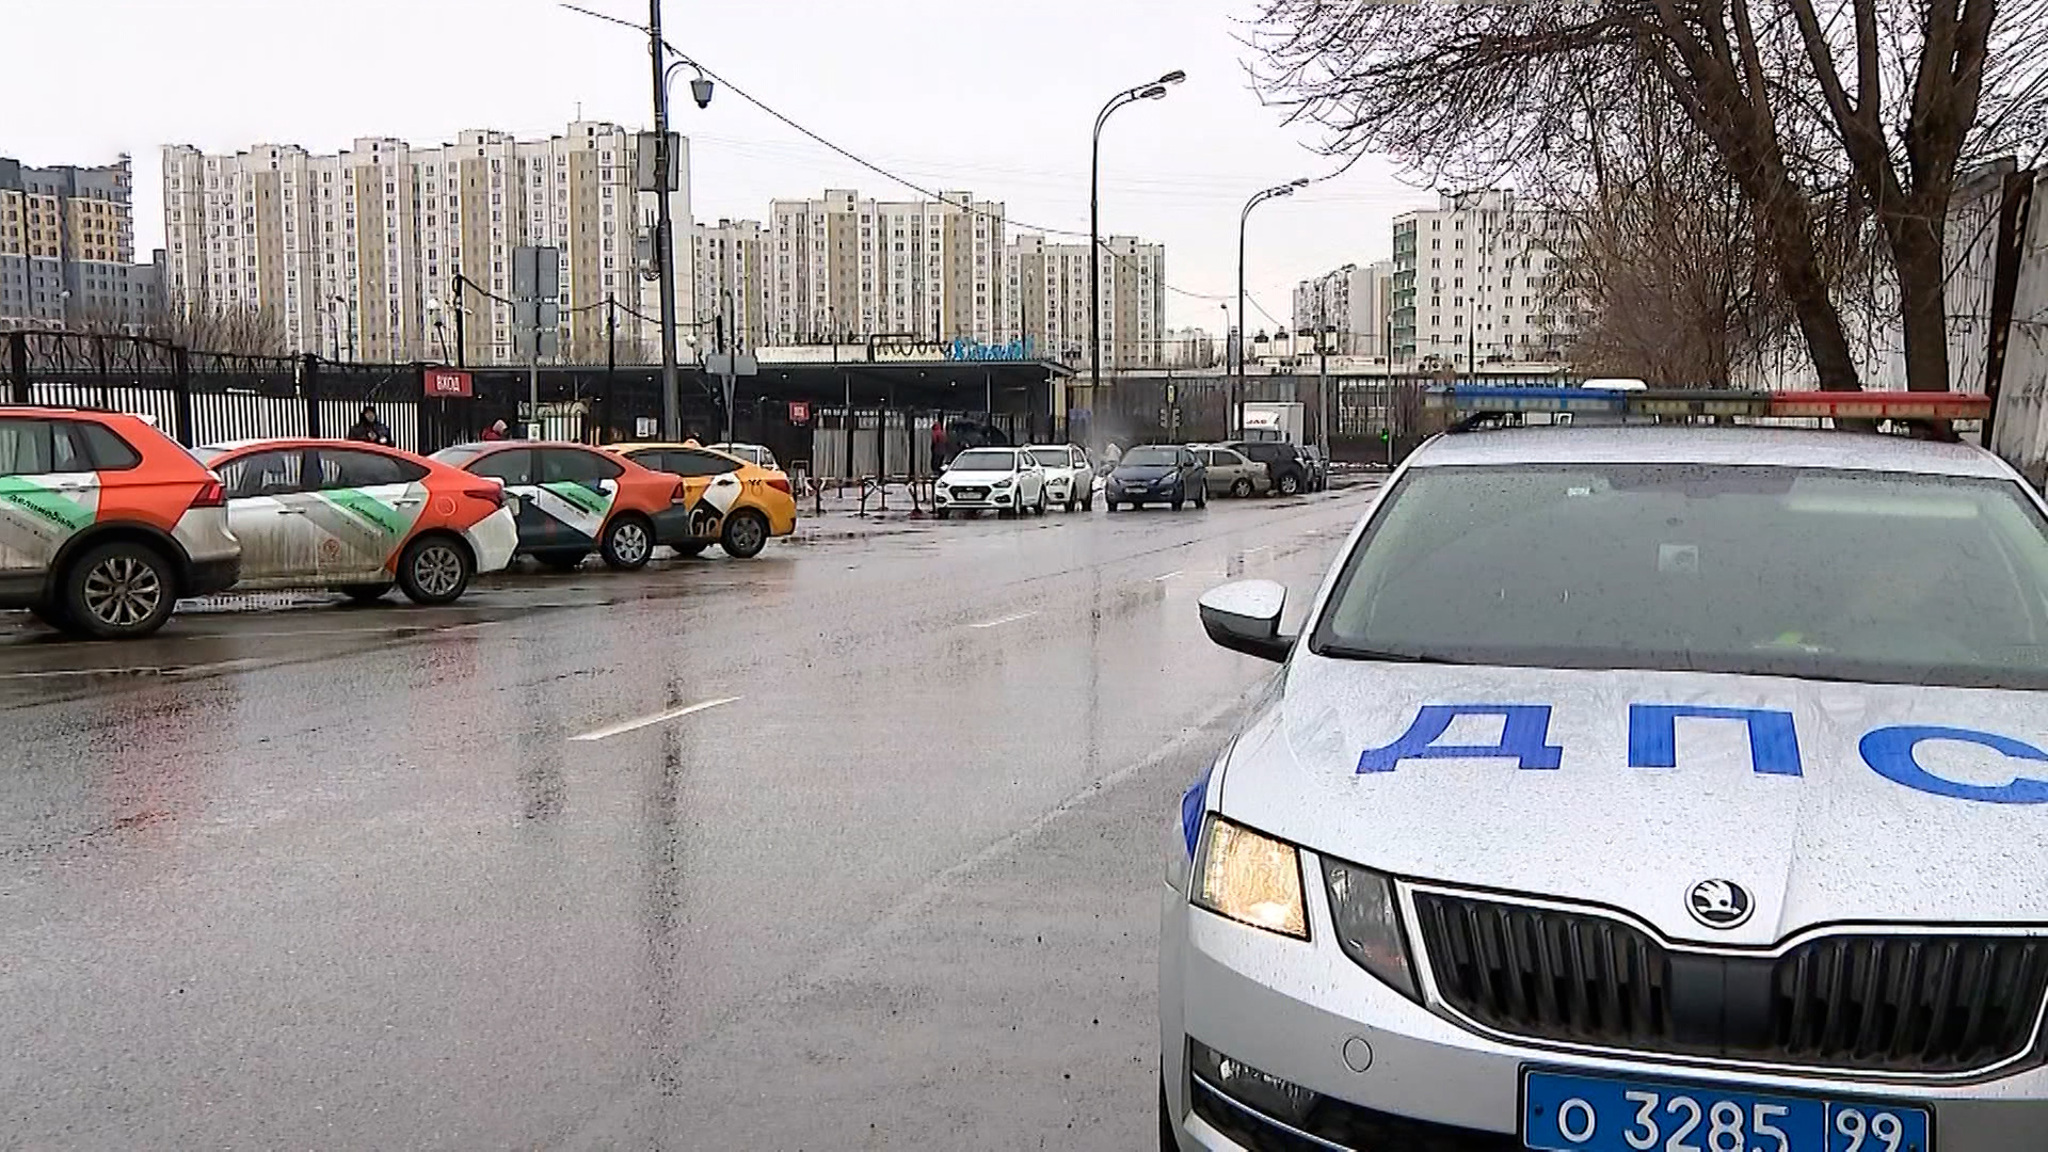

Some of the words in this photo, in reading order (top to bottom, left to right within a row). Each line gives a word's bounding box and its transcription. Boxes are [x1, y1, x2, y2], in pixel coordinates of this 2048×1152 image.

[436, 374, 461, 392] ВХОД
[1356, 702, 2048, 805] ДПС
[1623, 1090, 1791, 1152] 3285
[1834, 1107, 1903, 1152] 99
